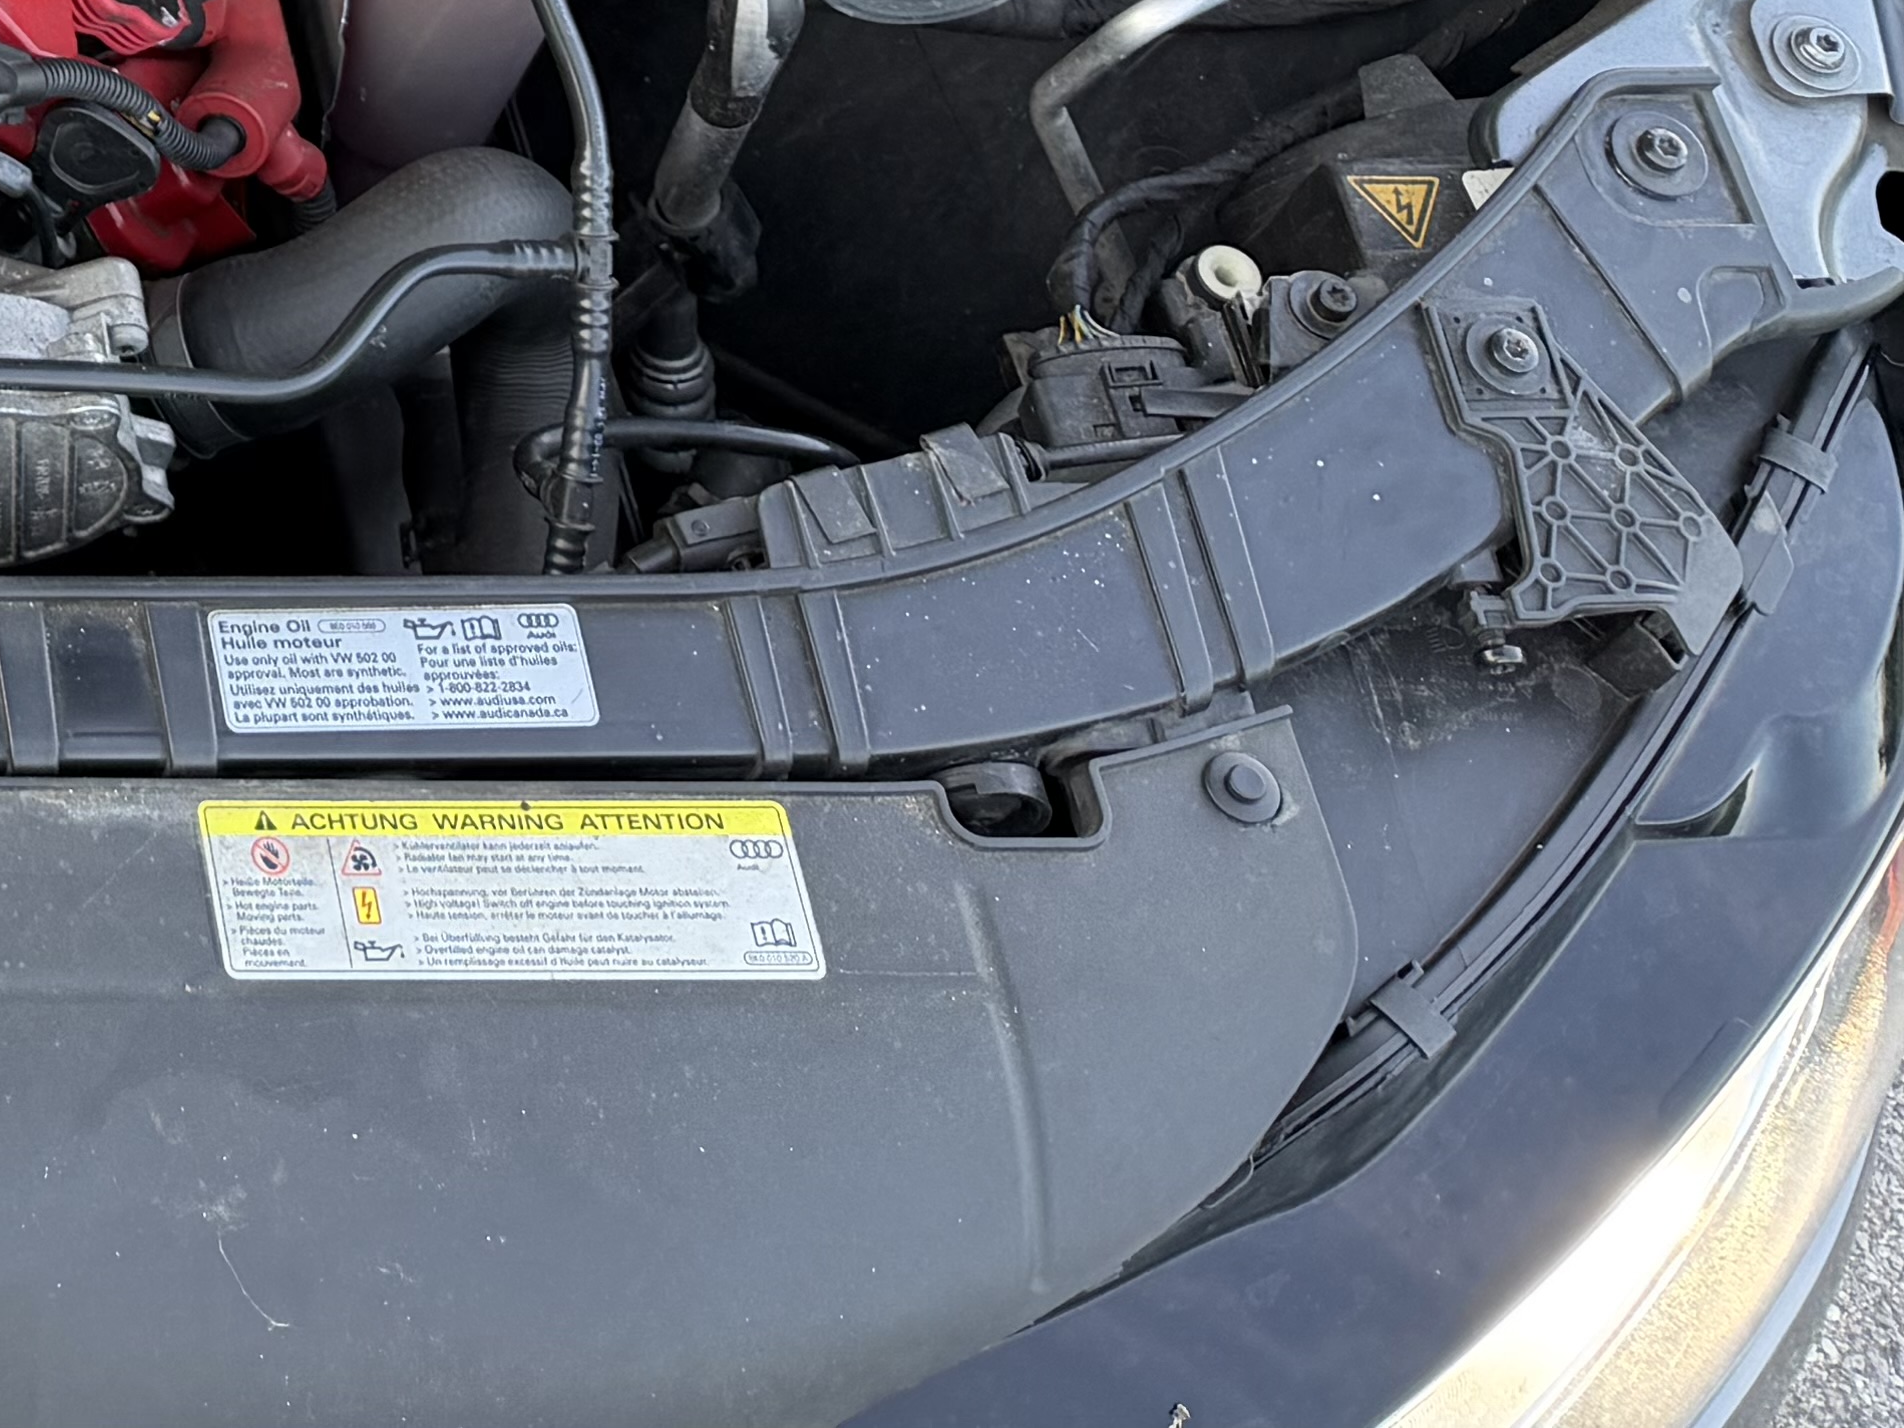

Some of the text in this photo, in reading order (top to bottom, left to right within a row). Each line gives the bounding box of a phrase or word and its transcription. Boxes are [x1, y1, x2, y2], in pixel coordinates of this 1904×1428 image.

[219, 620, 280, 637] Engine
[287, 619, 311, 633] Oil
[527, 630, 556, 639] Audi
[222, 637, 341, 649] Huile moteur
[417, 641, 577, 656] For a list of approved oils:
[224, 655, 248, 666] Use
[252, 654, 278, 667] only
[282, 653, 297, 665] oil
[300, 653, 328, 664] with
[330, 652, 353, 663] VW
[421, 657, 448, 668] Pour
[453, 659, 476, 667] une
[480, 656, 505, 667] liste
[228, 666, 406, 681] approval. Most are synthetic.
[230, 684, 276, 695] Utilisez
[279, 683, 353, 697] uniquement
[357, 683, 379, 694] des
[234, 699, 262, 709] avec
[265, 698, 286, 708] VW
[334, 695, 414, 710] approbation.
[441, 695, 556, 706] www.audiusa.com
[235, 710, 414, 725] La plupart sont synthétiques.
[443, 708, 568, 719] www.audicanada.ca
[291, 811, 724, 832] ACHTUNG WARNING ATTENTION
[467, 855, 487, 864] may
[235, 902, 252, 910] Hot
[256, 903, 289, 912] engine
[536, 900, 569, 910] engine
[572, 900, 604, 908] before
[607, 899, 650, 910] touching
[653, 899, 691, 910] ignition
[237, 912, 274, 923] Moving
[622, 911, 659, 920] toucher
[476, 946, 509, 956] engine
[513, 946, 524, 954] oil
[549, 946, 588, 956] damage
[427, 957, 442, 965] Un
